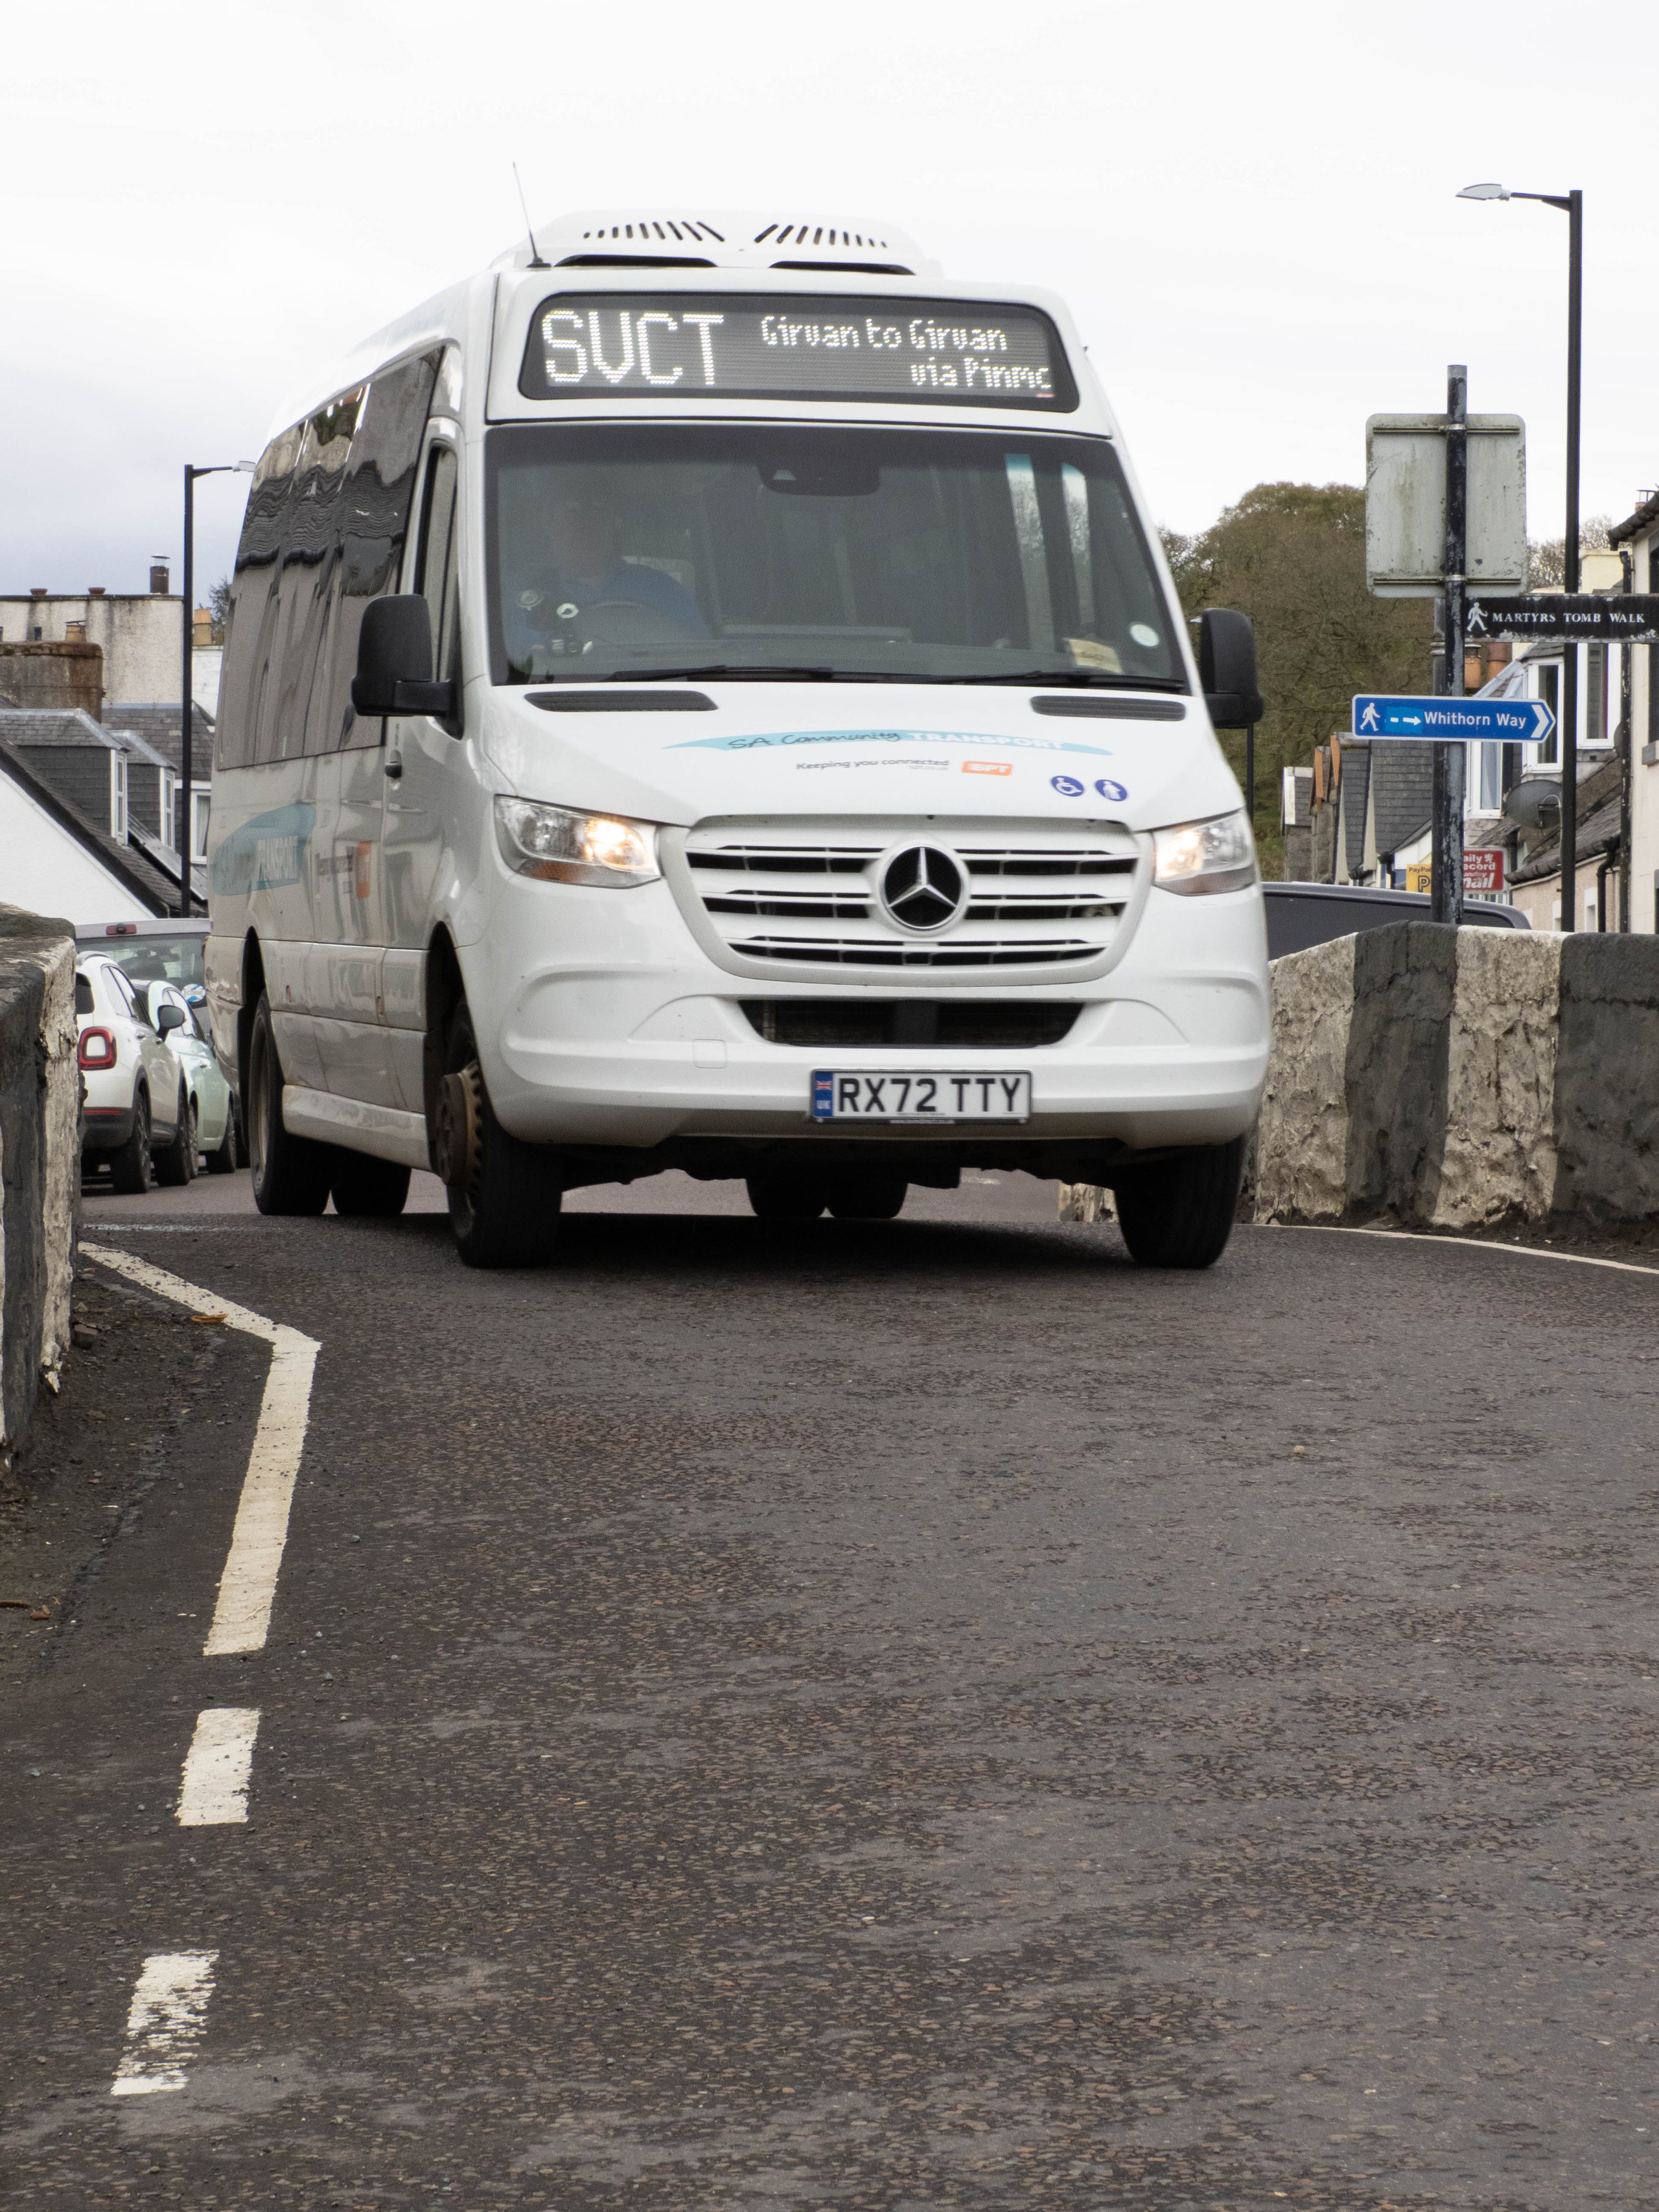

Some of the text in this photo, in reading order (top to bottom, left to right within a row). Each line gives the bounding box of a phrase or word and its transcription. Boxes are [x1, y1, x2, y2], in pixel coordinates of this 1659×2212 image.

[761, 316, 1007, 351] Girvan to Girvan
[542, 309, 724, 386] SVCT
[911, 356, 958, 386] via
[1492, 612, 1645, 623] MARTYRS TOMB WALK
[1424, 712, 1526, 728] Whithorn Way
[728, 737, 773, 749] SA
[907, 732, 1064, 749] TRANSPORT
[796, 760, 851, 769] Keeping
[1463, 854, 1483, 863] aily
[839, 1078, 1021, 1112] RX72 TTY
